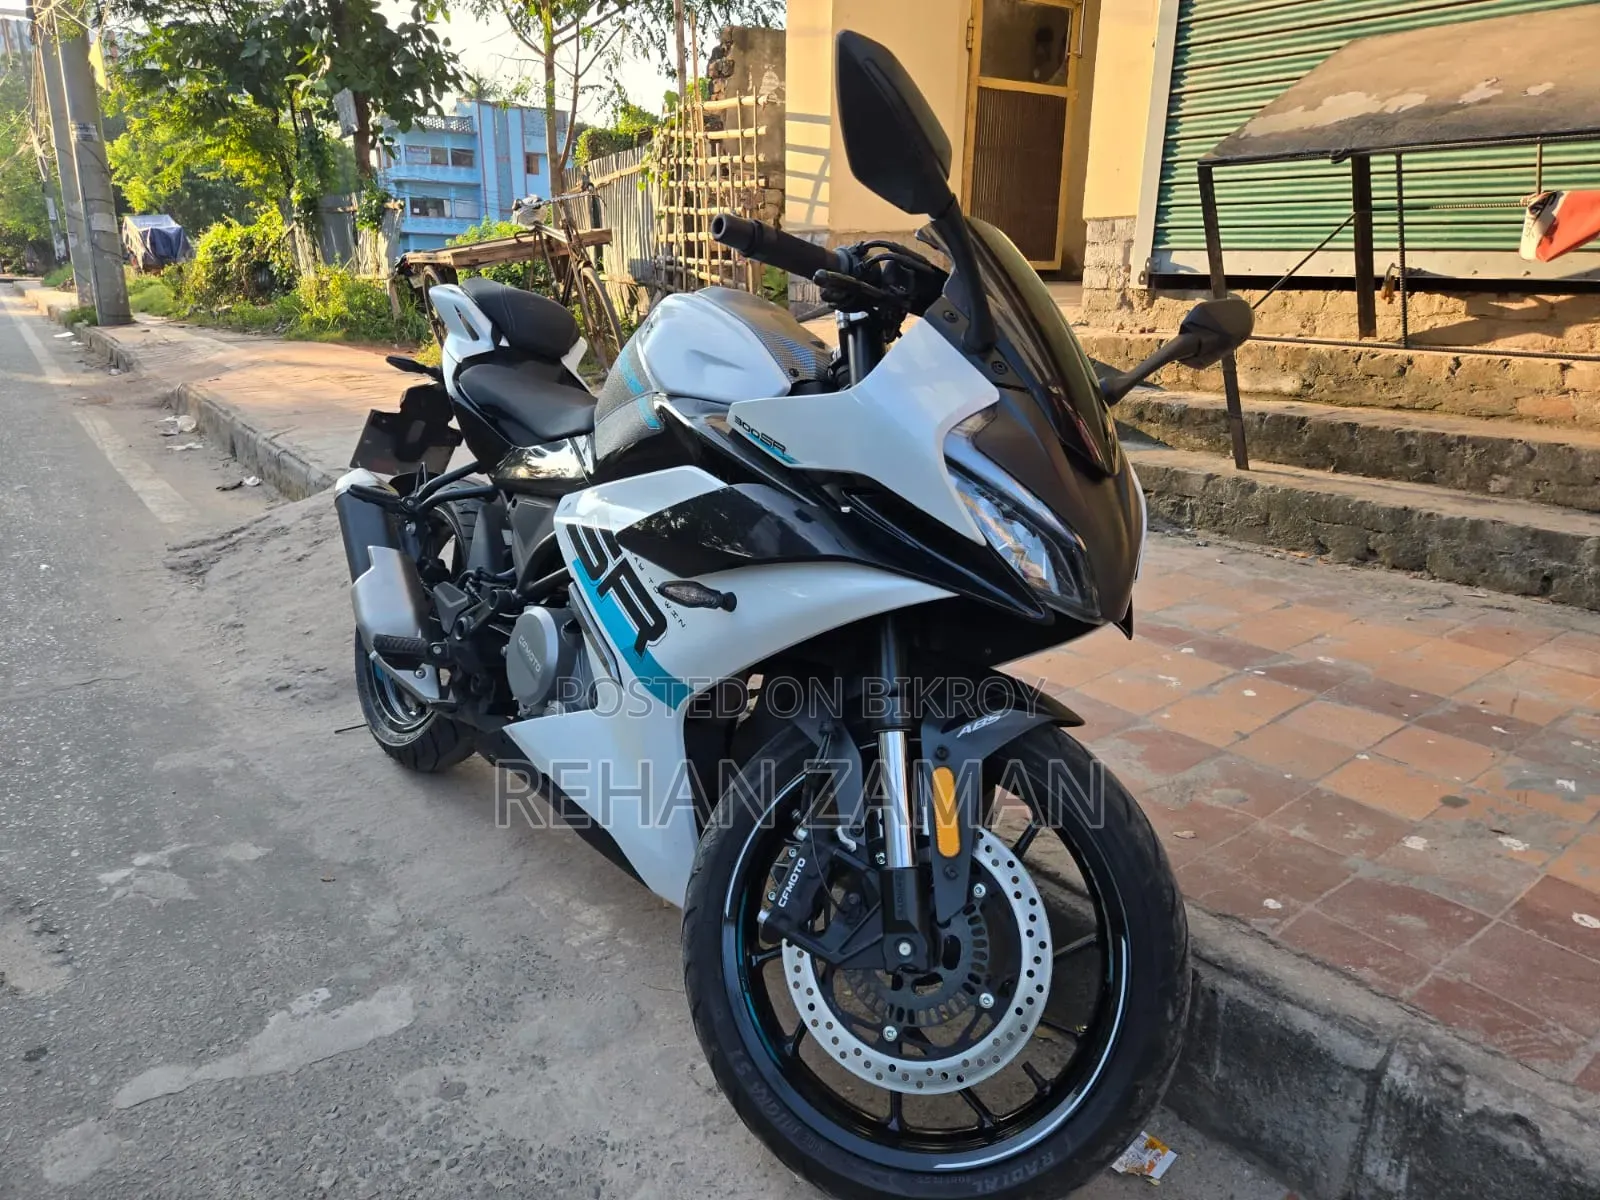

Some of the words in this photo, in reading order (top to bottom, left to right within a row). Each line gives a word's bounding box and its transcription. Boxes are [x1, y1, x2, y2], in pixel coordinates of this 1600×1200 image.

[734, 415, 786, 457] 300SR
[956, 714, 1001, 738] ABS
[777, 857, 806, 908] CFMOTO
